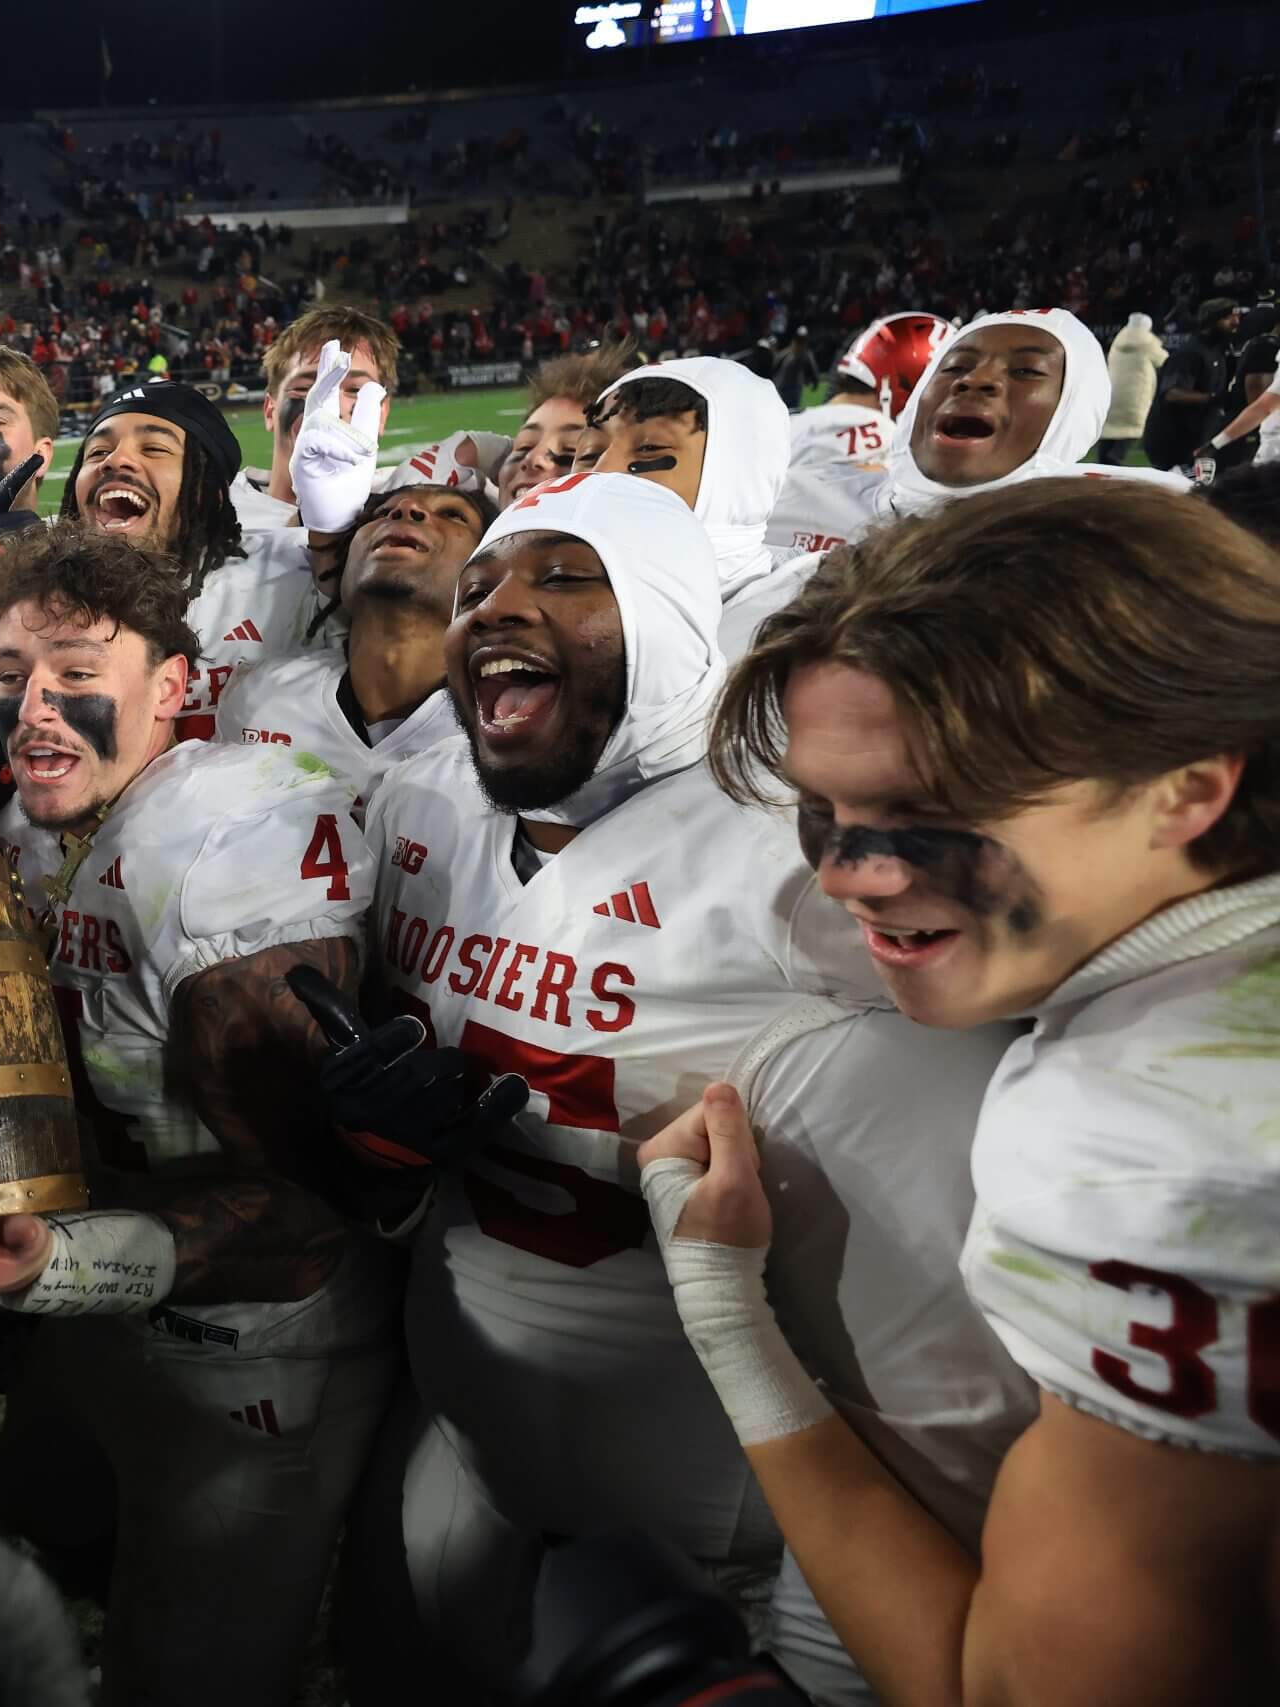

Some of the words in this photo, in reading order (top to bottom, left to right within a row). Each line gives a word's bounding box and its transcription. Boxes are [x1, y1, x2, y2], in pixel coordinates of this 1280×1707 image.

[836, 421, 882, 456] 75
[300, 813, 352, 901] 4
[385, 904, 637, 1033] HOOSIERS
